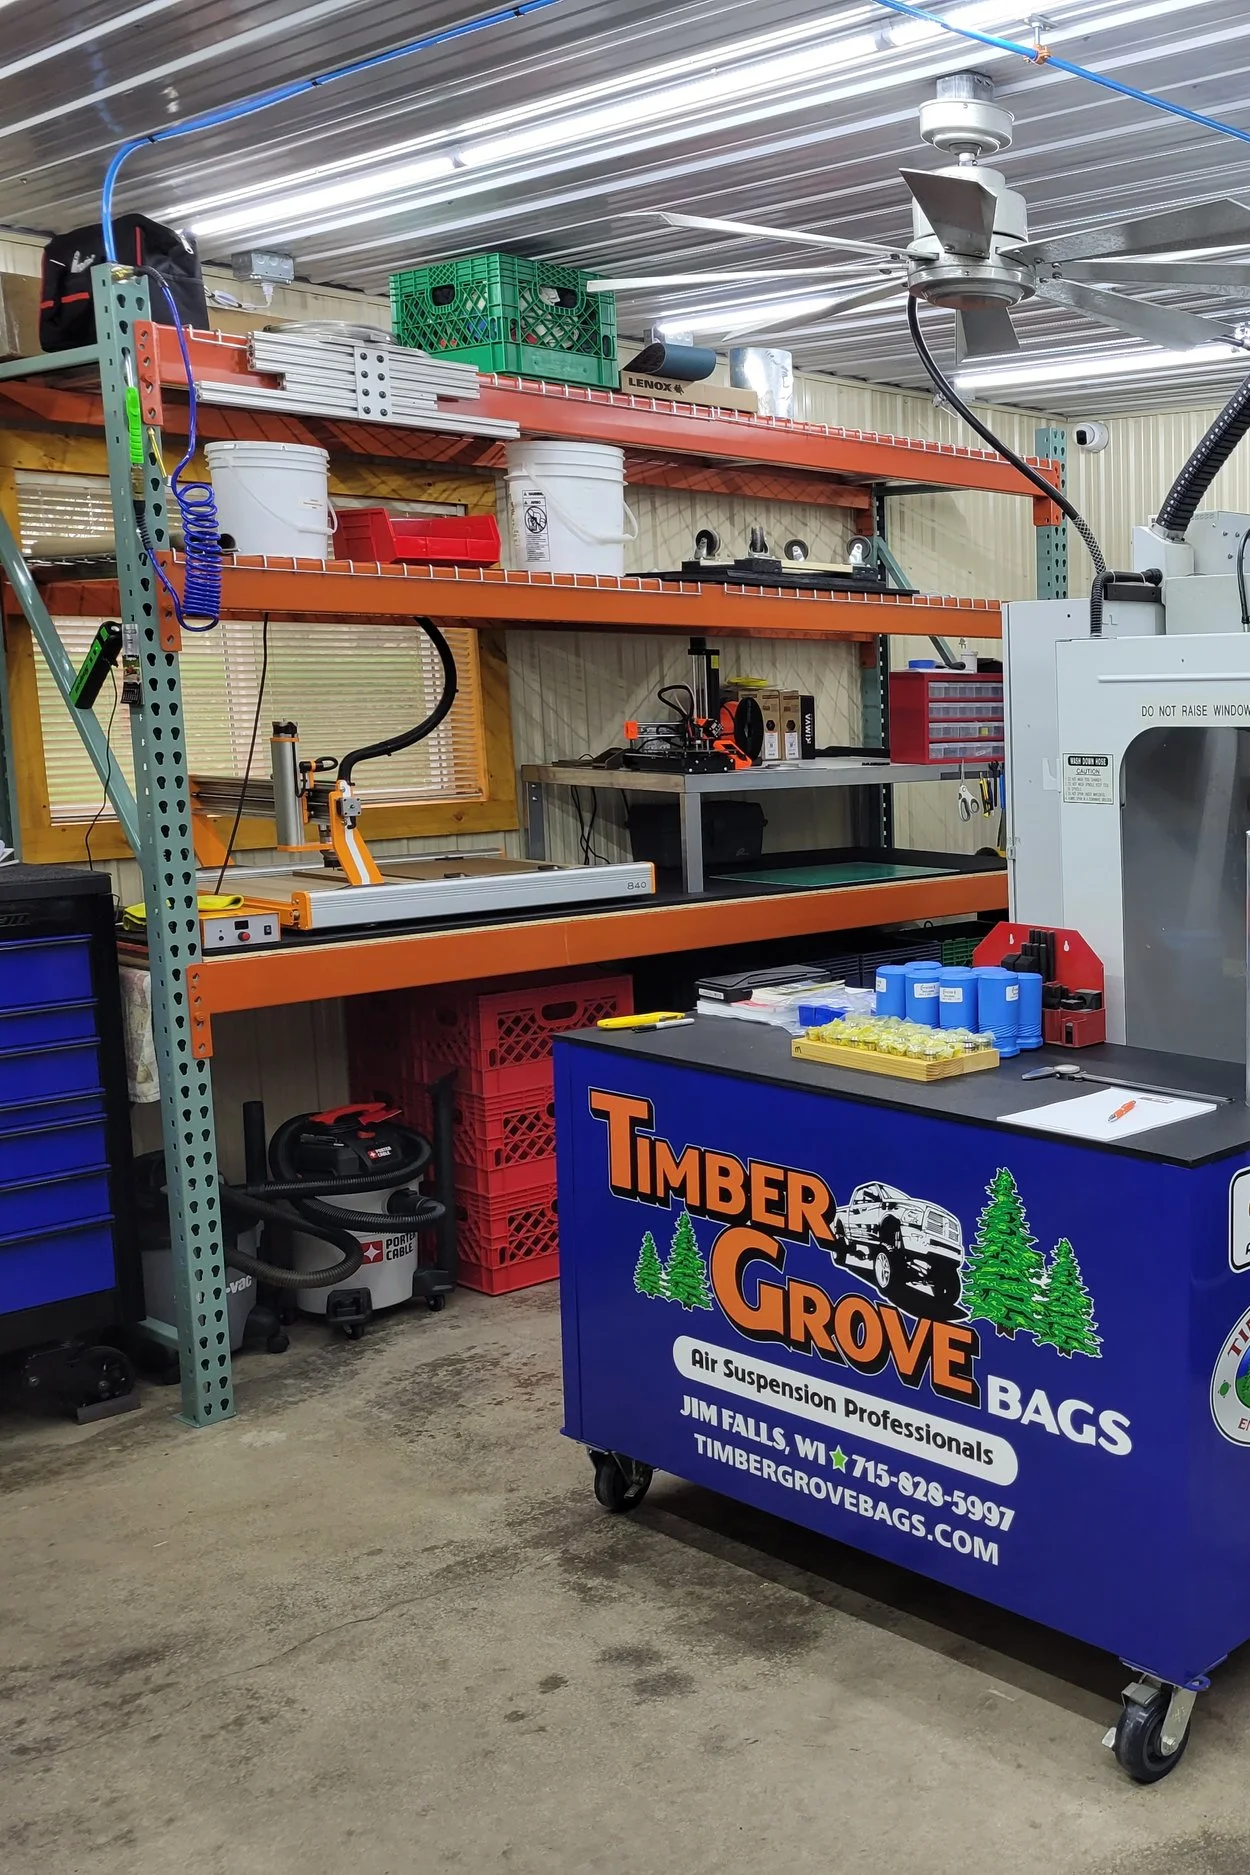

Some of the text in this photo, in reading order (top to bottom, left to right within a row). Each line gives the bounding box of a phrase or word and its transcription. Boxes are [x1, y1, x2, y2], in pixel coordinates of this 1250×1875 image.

[628, 377, 673, 392] LENOX
[1141, 705, 1154, 717] DO
[1159, 705, 1176, 717] NOT
[1181, 704, 1208, 717] RAISE
[627, 881, 647, 890] 840
[590, 1088, 837, 1247] TIMBER
[386, 1242, 413, 1261] CABLE
[710, 1224, 980, 1406] GROVE
[691, 1348, 994, 1466] Air Suspension Professionals
[987, 1374, 1133, 1456] BAGS
[680, 1395, 1016, 1532] JIM FALLS, WI 715-828-5997
[693, 1432, 999, 1566] TIMBERGROVEBAGS.COM
